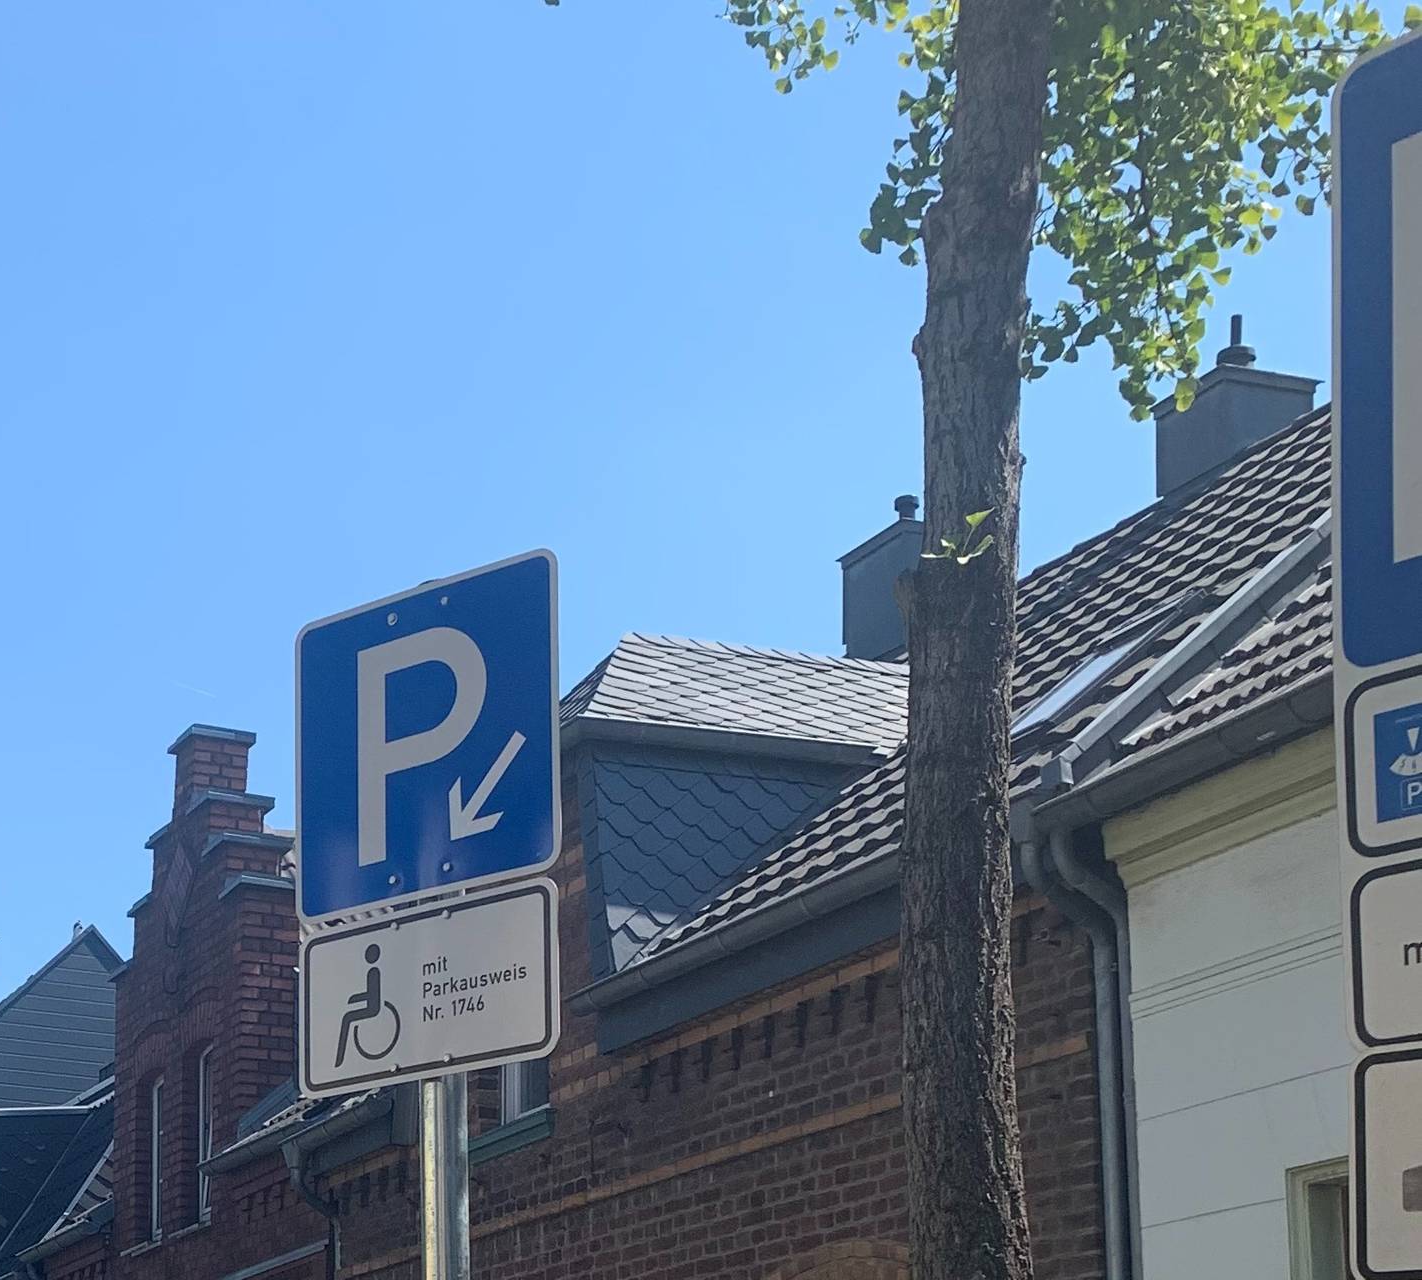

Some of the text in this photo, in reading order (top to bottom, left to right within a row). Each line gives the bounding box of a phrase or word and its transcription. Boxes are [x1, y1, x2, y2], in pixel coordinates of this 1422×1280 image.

[357, 626, 487, 867] P
[1407, 781, 1422, 805] P
[422, 956, 448, 976] mit
[423, 963, 527, 998] Parkausweis
[423, 995, 485, 1022] Nr. 1746
